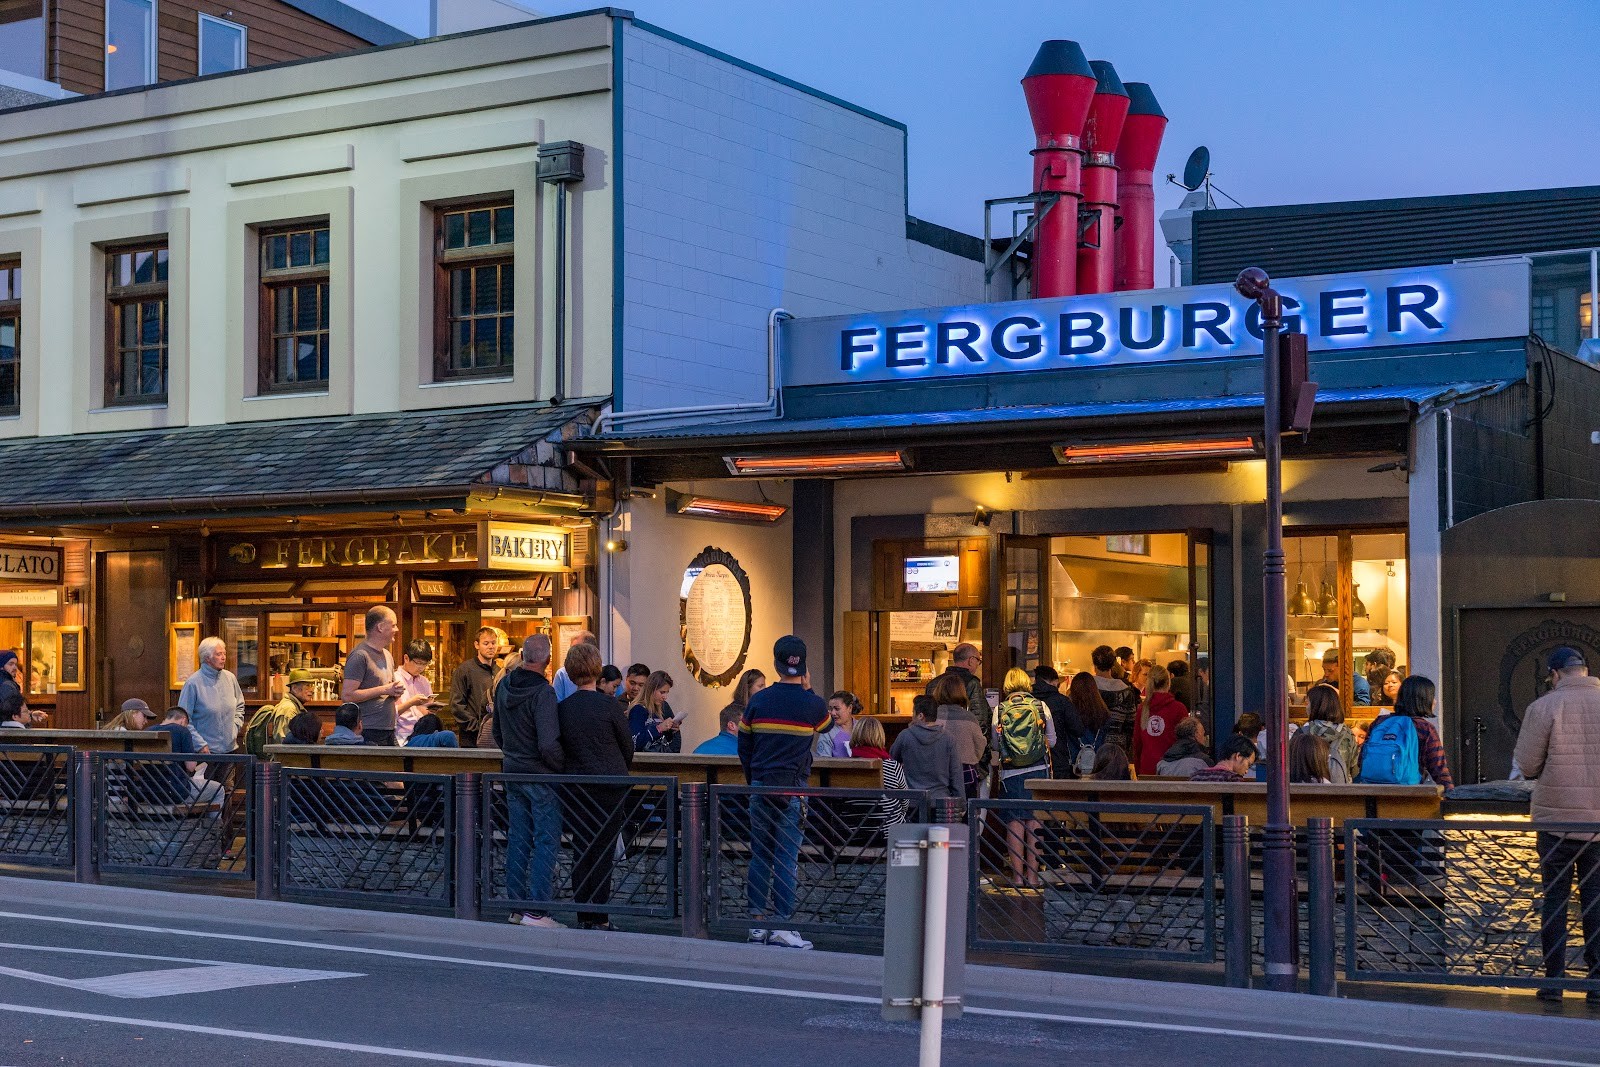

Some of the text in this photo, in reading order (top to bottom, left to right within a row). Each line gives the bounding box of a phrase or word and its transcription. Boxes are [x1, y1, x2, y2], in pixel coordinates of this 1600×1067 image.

[841, 284, 1444, 370] FERGBURGER
[276, 533, 469, 565] FERGBAKE
[491, 535, 562, 560] BAKERY
[0, 554, 54, 574] LATO
[420, 584, 443, 593] CAKE
[480, 582, 525, 591] ARTISAN
